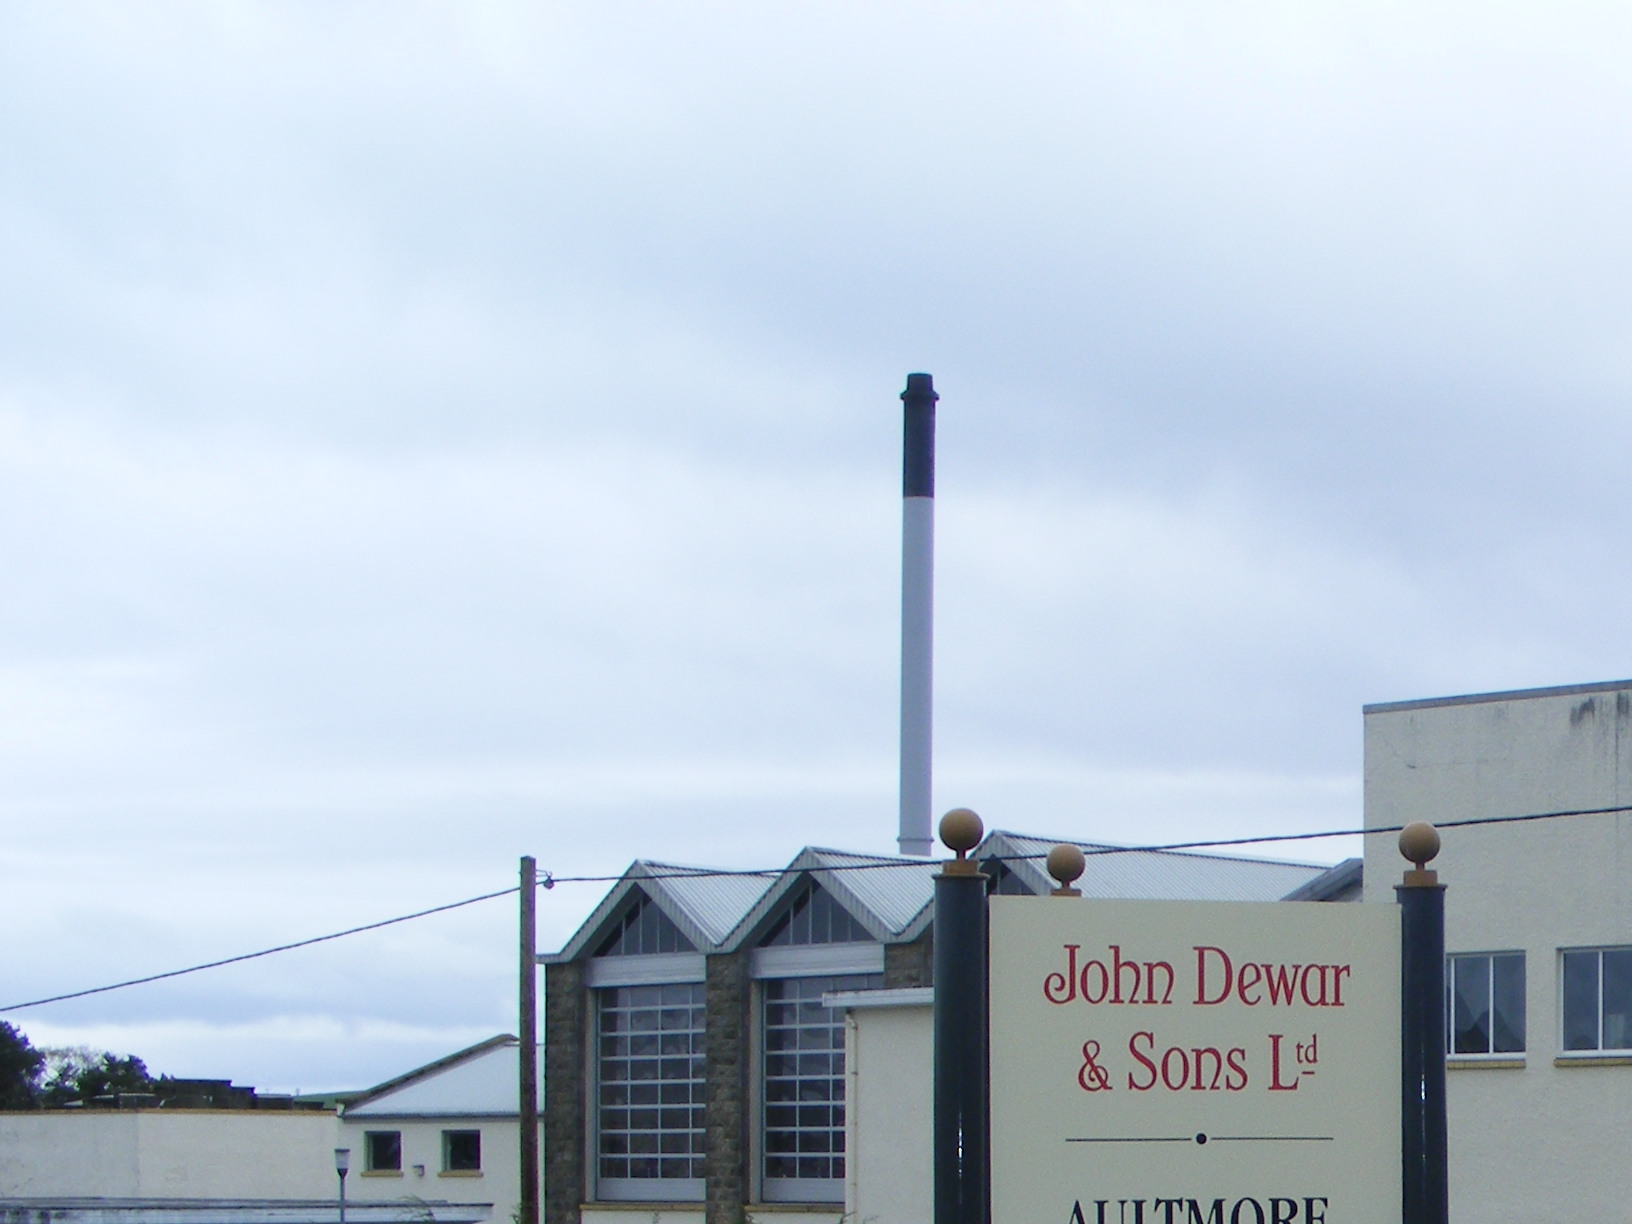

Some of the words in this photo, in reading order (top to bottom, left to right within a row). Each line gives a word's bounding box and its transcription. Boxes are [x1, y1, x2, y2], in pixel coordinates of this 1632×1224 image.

[1044, 944, 1175, 1006] John
[1193, 946, 1350, 1007] Dewar
[1078, 1039, 1113, 1091] &
[1127, 1031, 1248, 1092] Sons
[1268, 1034, 1318, 1092] Ltd
